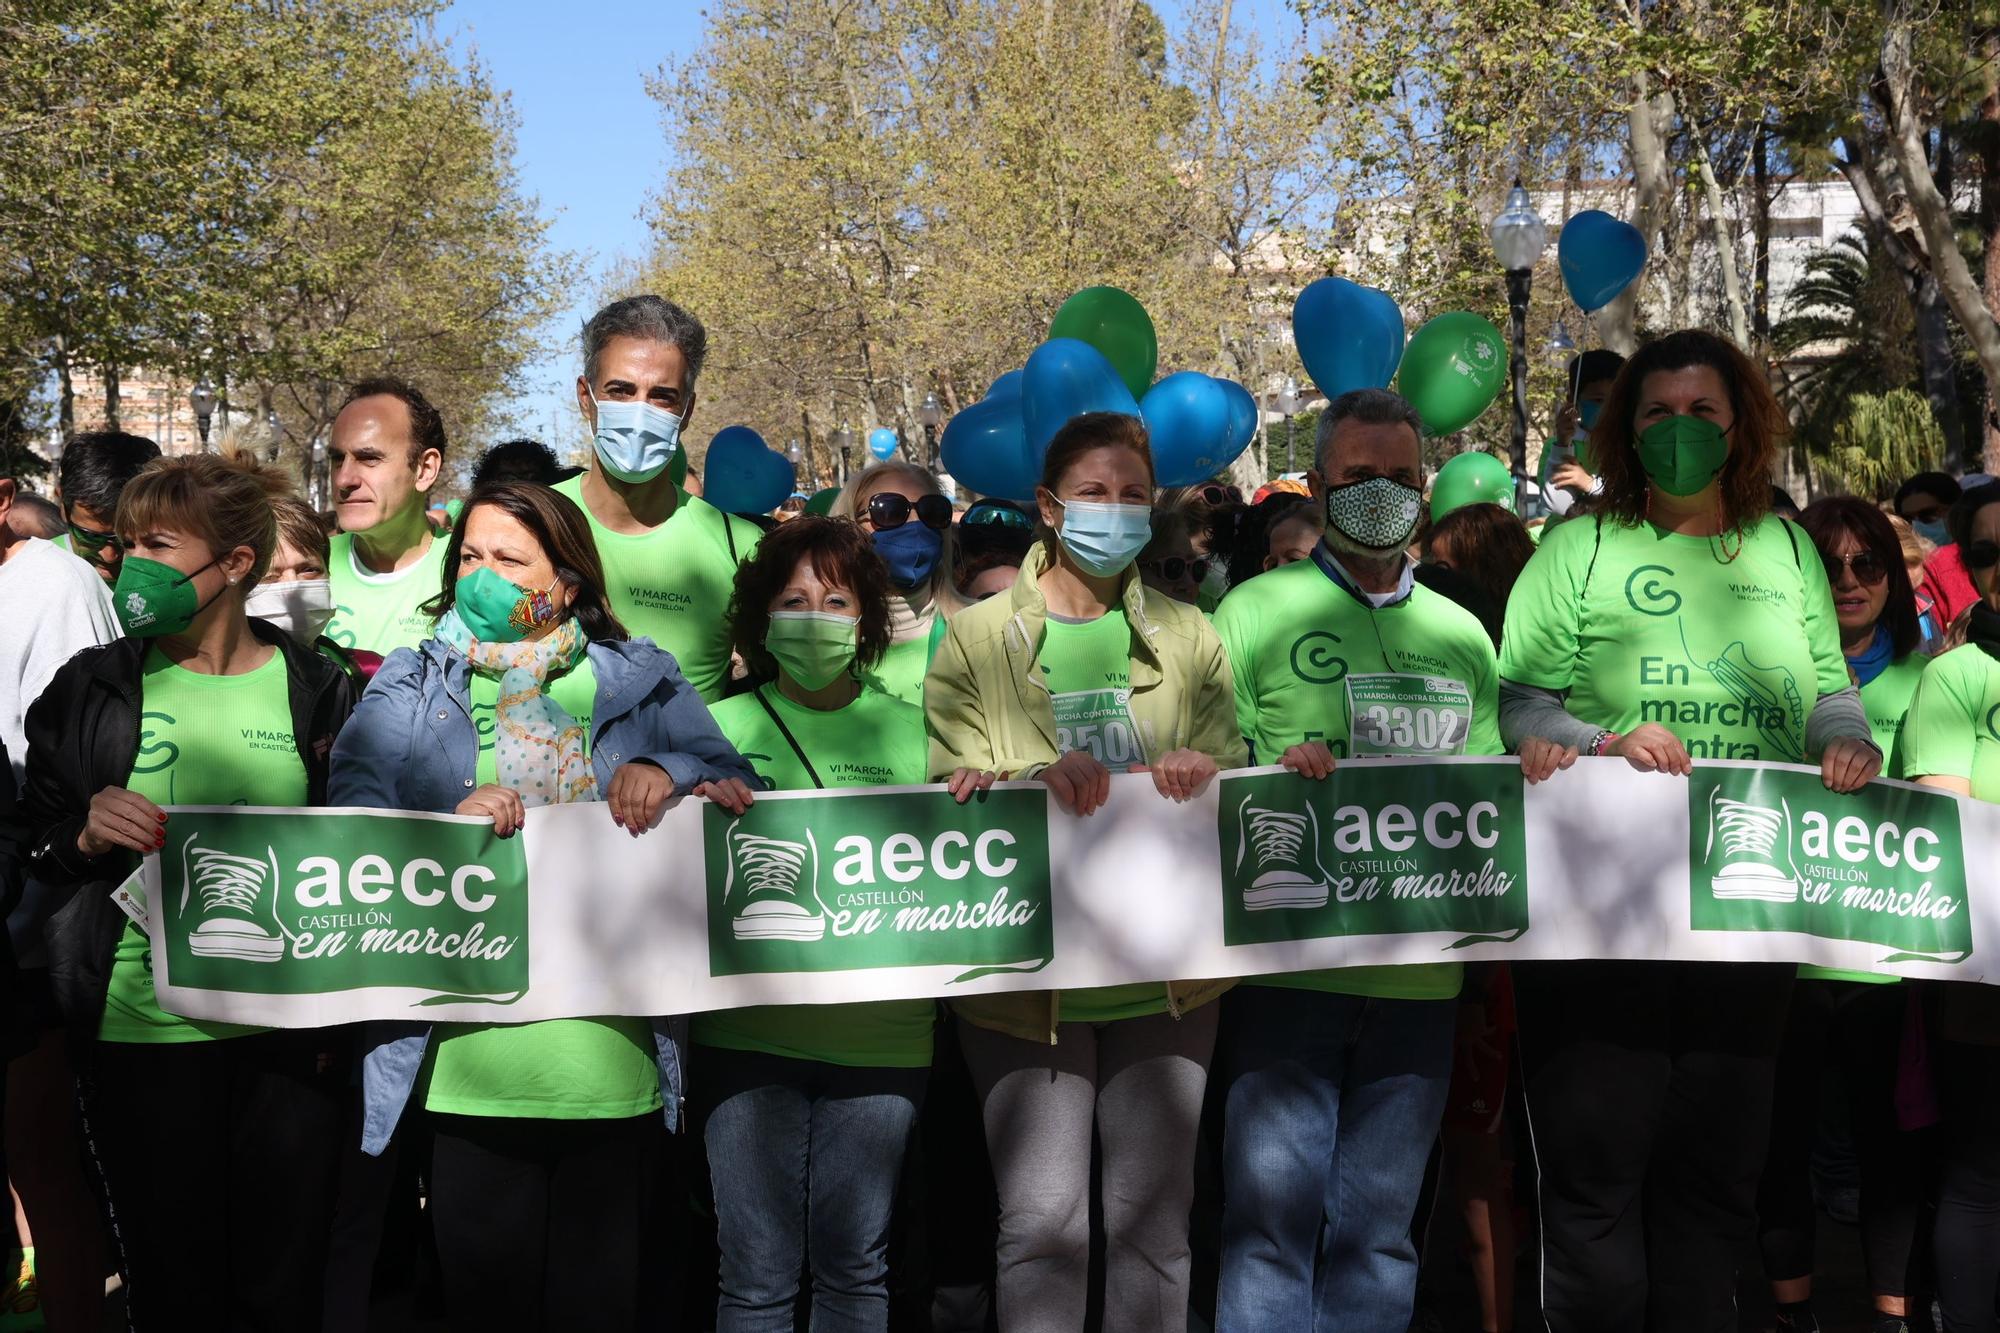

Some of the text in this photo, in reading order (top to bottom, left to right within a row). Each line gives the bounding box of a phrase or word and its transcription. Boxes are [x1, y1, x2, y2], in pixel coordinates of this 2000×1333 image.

[629, 587, 692, 604] VI MARCHA
[1729, 584, 1739, 592] VI
[645, 601, 684, 611] CASTELLÓN
[1395, 649, 1449, 670] VI MARCHA
[1413, 664, 1446, 676] CASTELLÓN
[1105, 673, 1117, 681] VI
[1641, 657, 1688, 685] En
[915, 682, 921, 690] V
[1364, 692, 1397, 700] MARCHA
[1398, 694, 1428, 702] CONTRA
[1439, 693, 1467, 704] CÁNCER
[1083, 709, 1117, 719] CONTRA
[1641, 697, 1786, 730] marcha
[241, 729, 253, 739] VI
[1368, 705, 1457, 749] 3302
[1687, 734, 1760, 760] ntra
[830, 764, 894, 776] VI MARCHA
[1333, 801, 1500, 853] aecc
[1801, 811, 1941, 872] aecc
[832, 829, 1018, 885] aecc
[1340, 856, 1418, 873] CASTELLÓN
[294, 854, 497, 913] aecc
[1336, 857, 1517, 902] en marcha
[1804, 863, 1868, 883] CASTELLÓN
[837, 887, 924, 907] CASTELLÓN
[1802, 879, 1961, 919] en marcha
[299, 908, 392, 930] CASTELLÓN
[832, 886, 1040, 936] en marcha
[292, 922, 519, 961] en marcha
